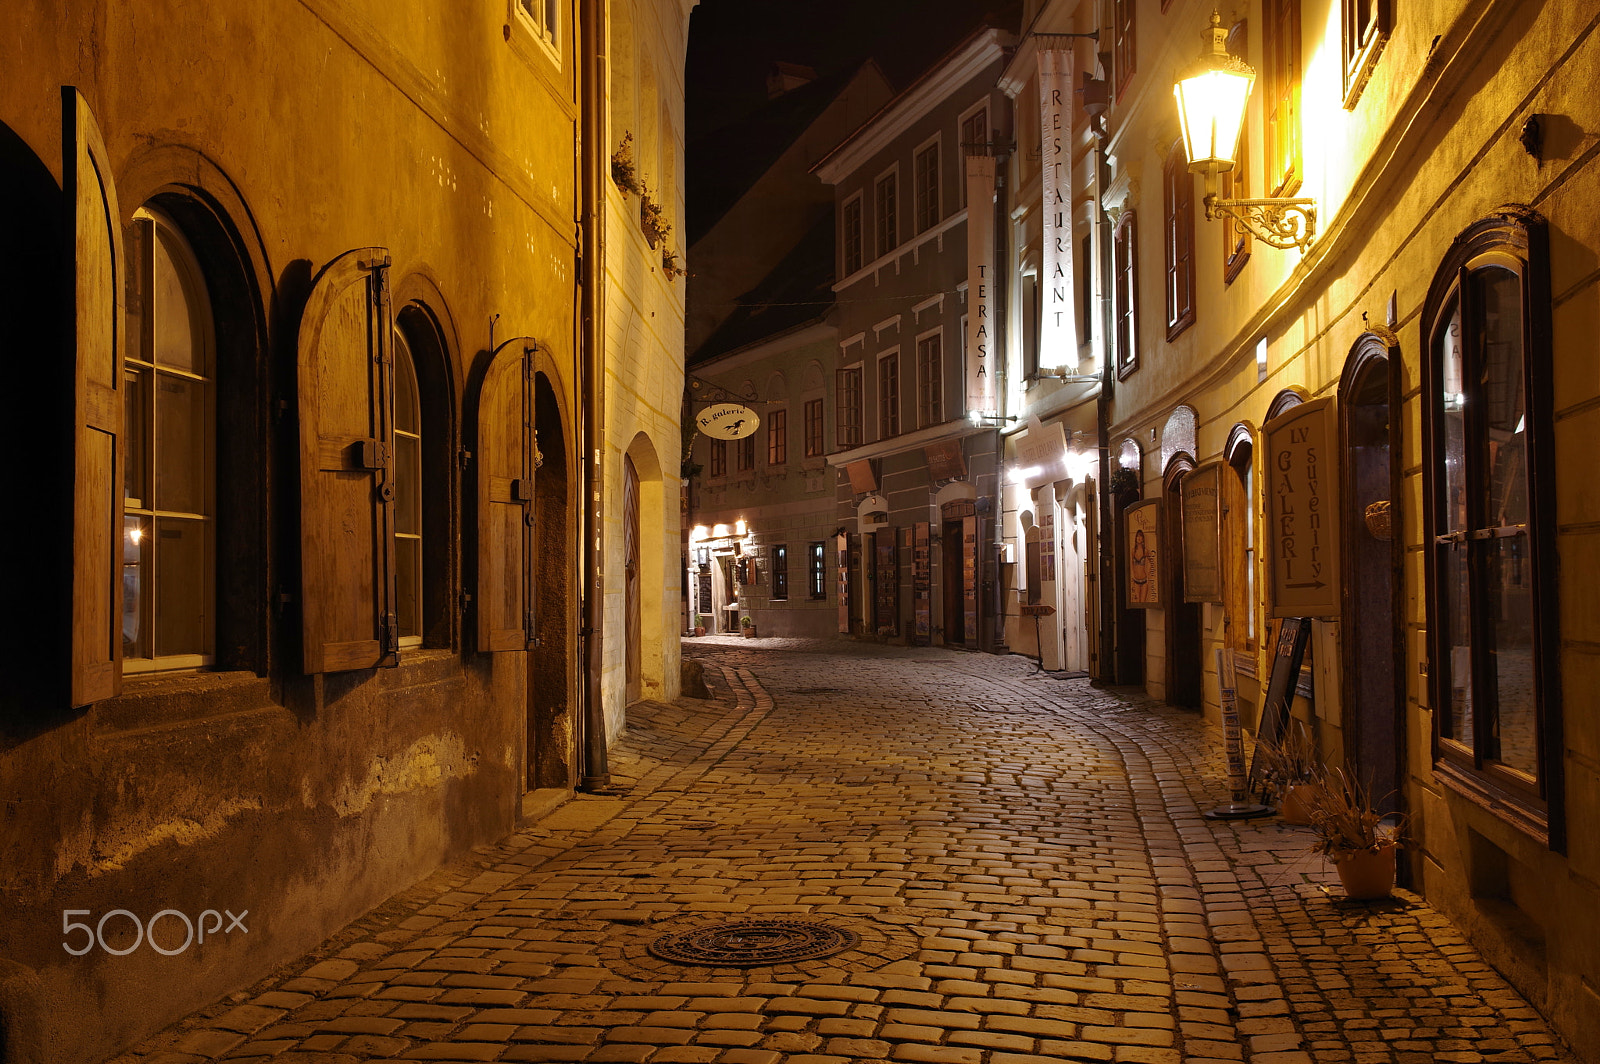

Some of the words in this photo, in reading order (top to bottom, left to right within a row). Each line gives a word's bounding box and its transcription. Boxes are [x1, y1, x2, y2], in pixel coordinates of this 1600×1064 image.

[1051, 89, 1064, 327] RESTAURANT
[976, 265, 988, 378] TERASA
[700, 418, 711, 428] R.
[712, 408, 745, 421] galerie
[1290, 427, 1309, 444] LV
[1277, 450, 1298, 580] GALERI
